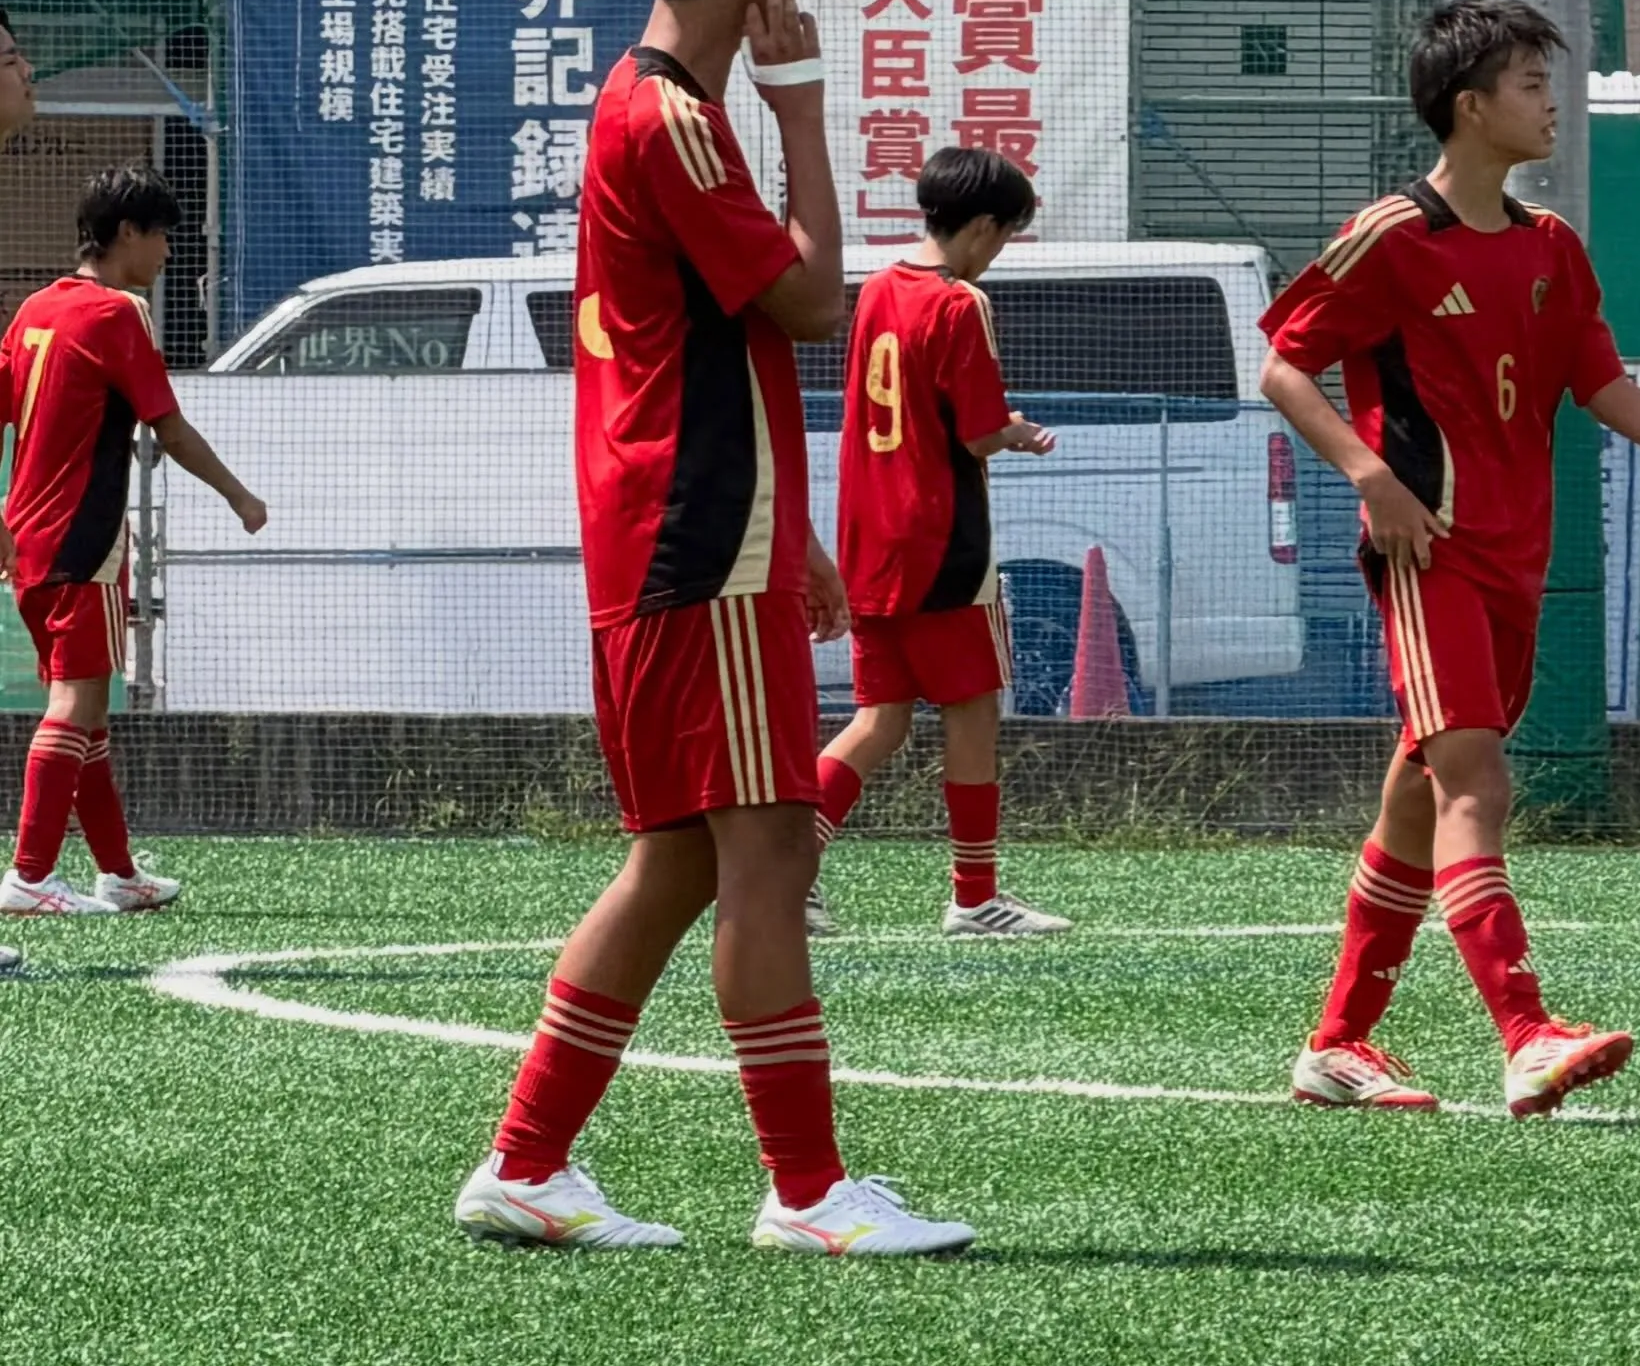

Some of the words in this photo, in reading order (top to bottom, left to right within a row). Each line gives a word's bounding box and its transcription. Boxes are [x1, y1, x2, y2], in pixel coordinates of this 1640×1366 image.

[19, 327, 55, 441] 7
[866, 331, 902, 453] 9
[1496, 353, 1516, 422] 6
